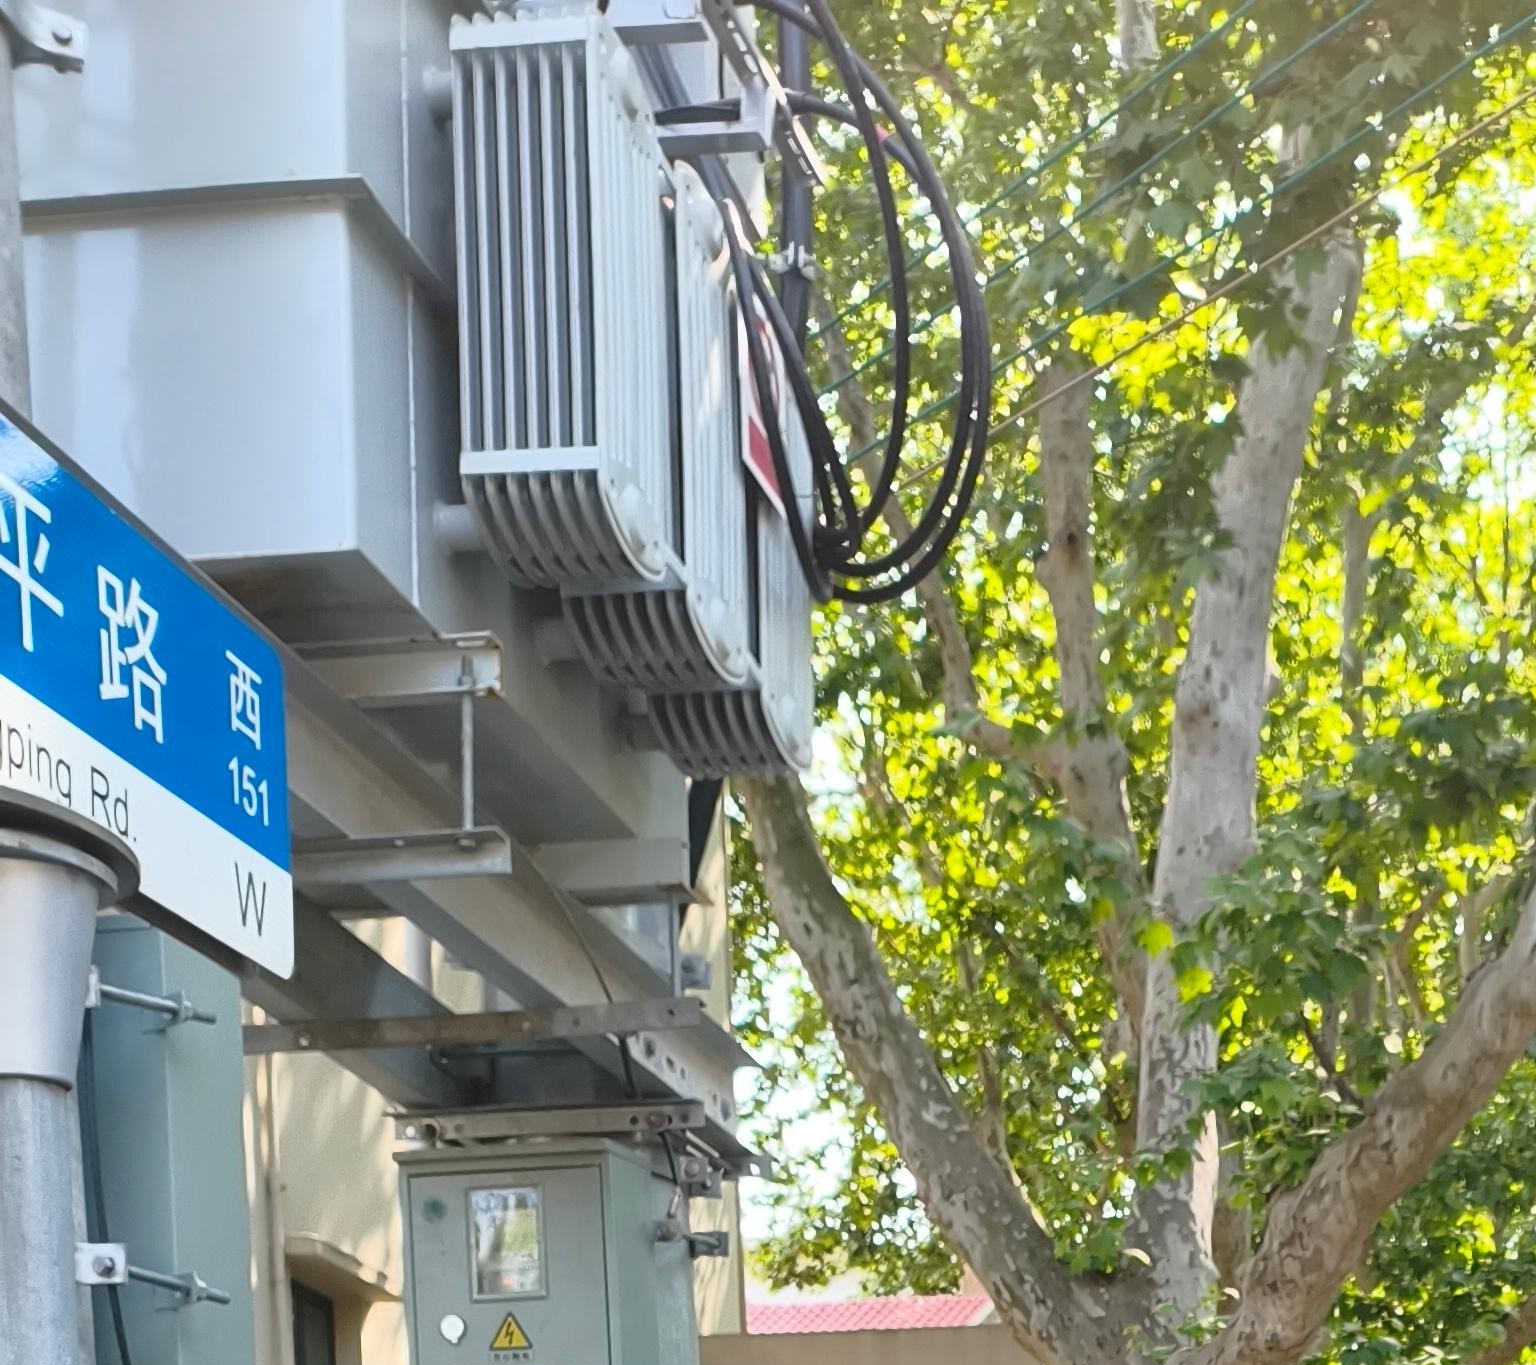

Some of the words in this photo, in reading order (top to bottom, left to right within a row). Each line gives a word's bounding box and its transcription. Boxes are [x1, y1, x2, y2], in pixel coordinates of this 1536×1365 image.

[225, 650, 263, 750] 西
[0, 720, 71, 808] ping
[91, 765, 137, 843] Rd.
[228, 756, 270, 826] 151
[234, 862, 266, 937] W
